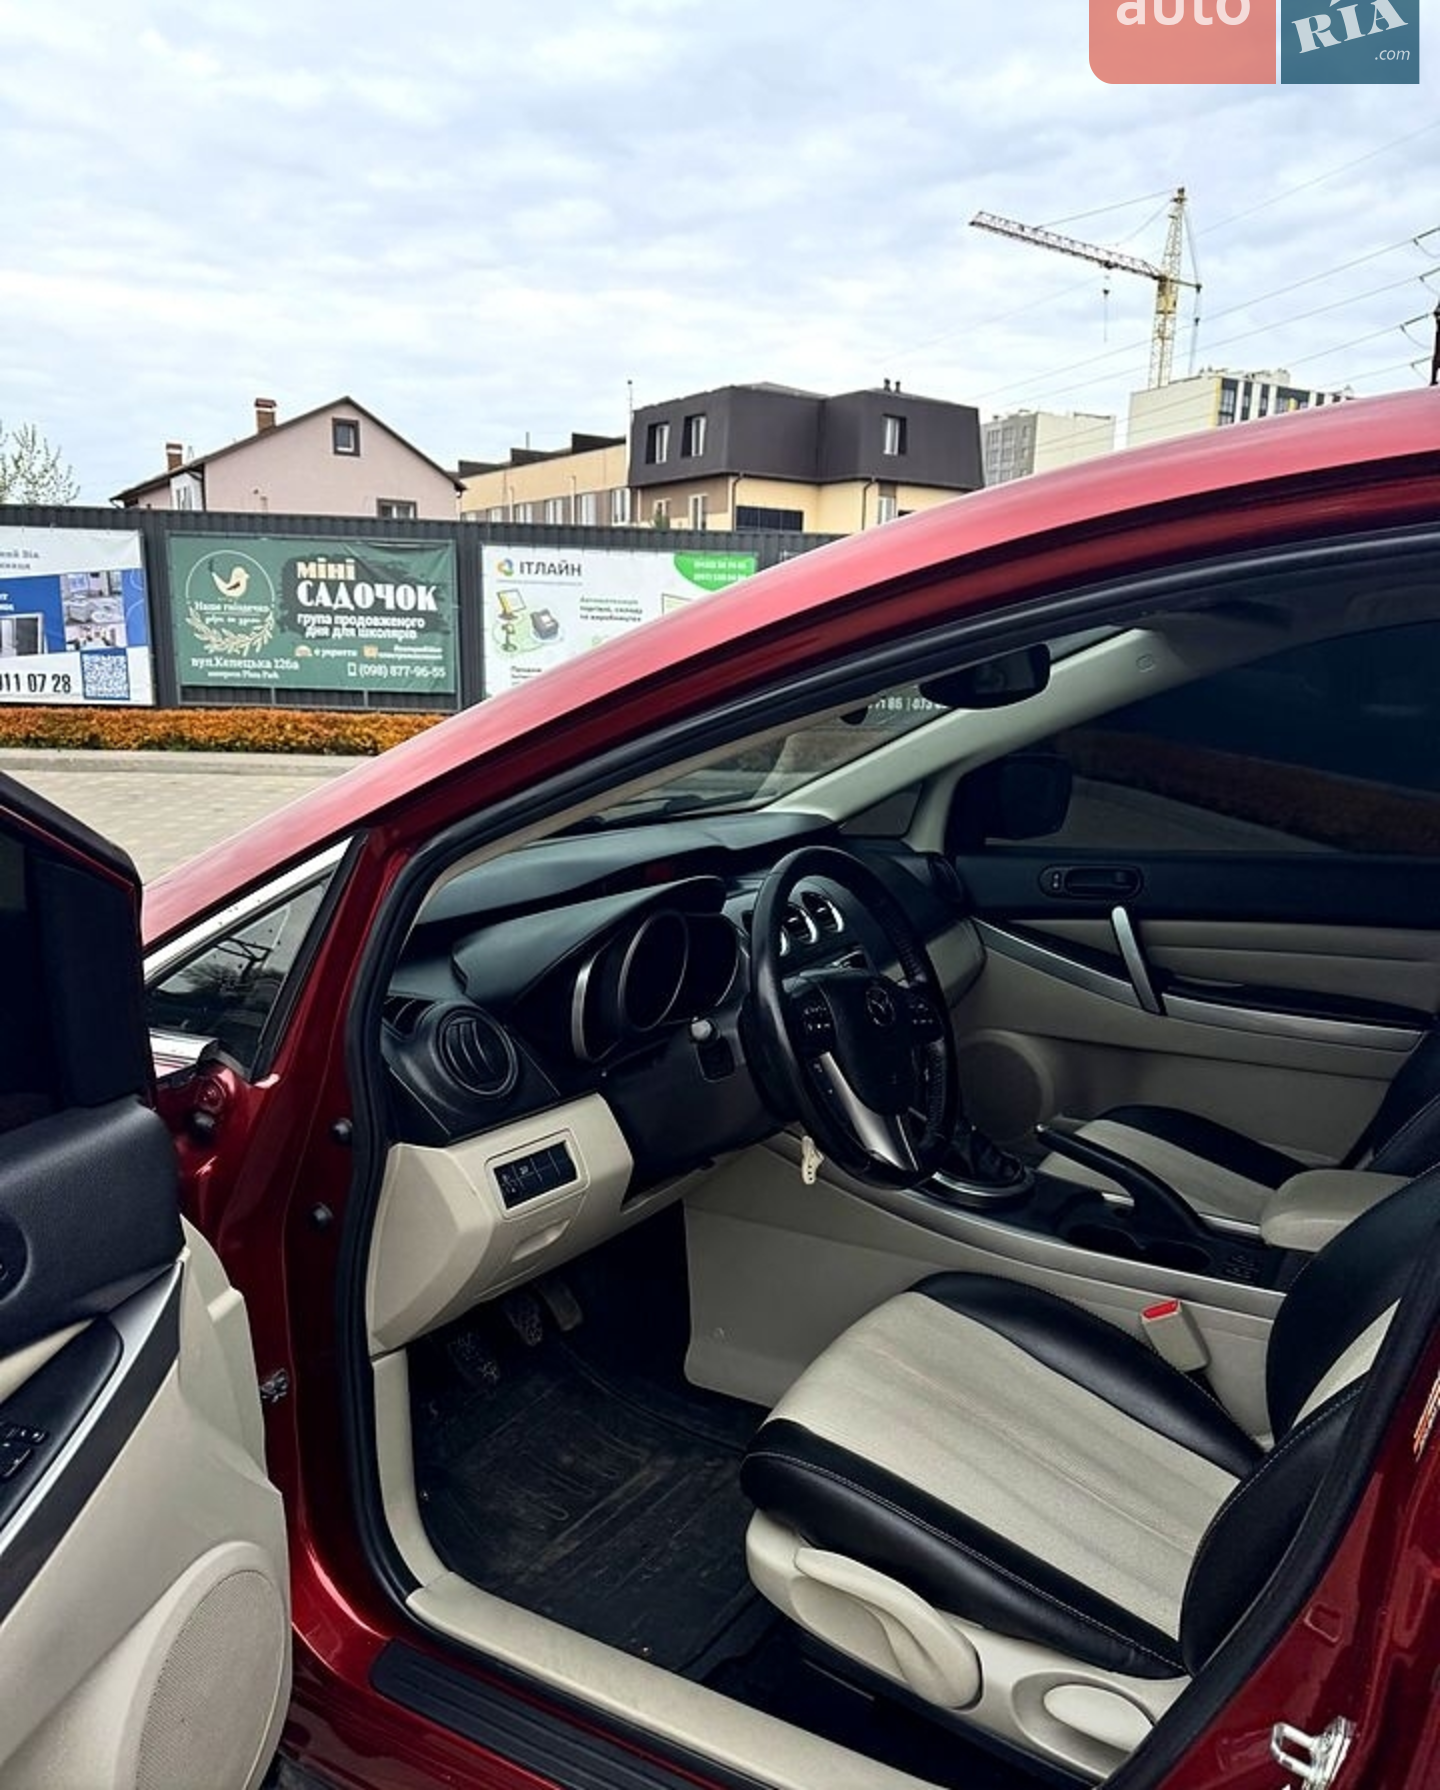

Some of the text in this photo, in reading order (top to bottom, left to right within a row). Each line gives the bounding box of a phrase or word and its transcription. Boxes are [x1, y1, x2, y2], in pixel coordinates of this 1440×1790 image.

[520, 560, 582, 577] ІТЛАЙН
[297, 580, 437, 611] САДОЧОК
[297, 613, 425, 629] група продовженого
[305, 626, 418, 642] дня для школярів
[0, 673, 71, 694] 11 07 28
